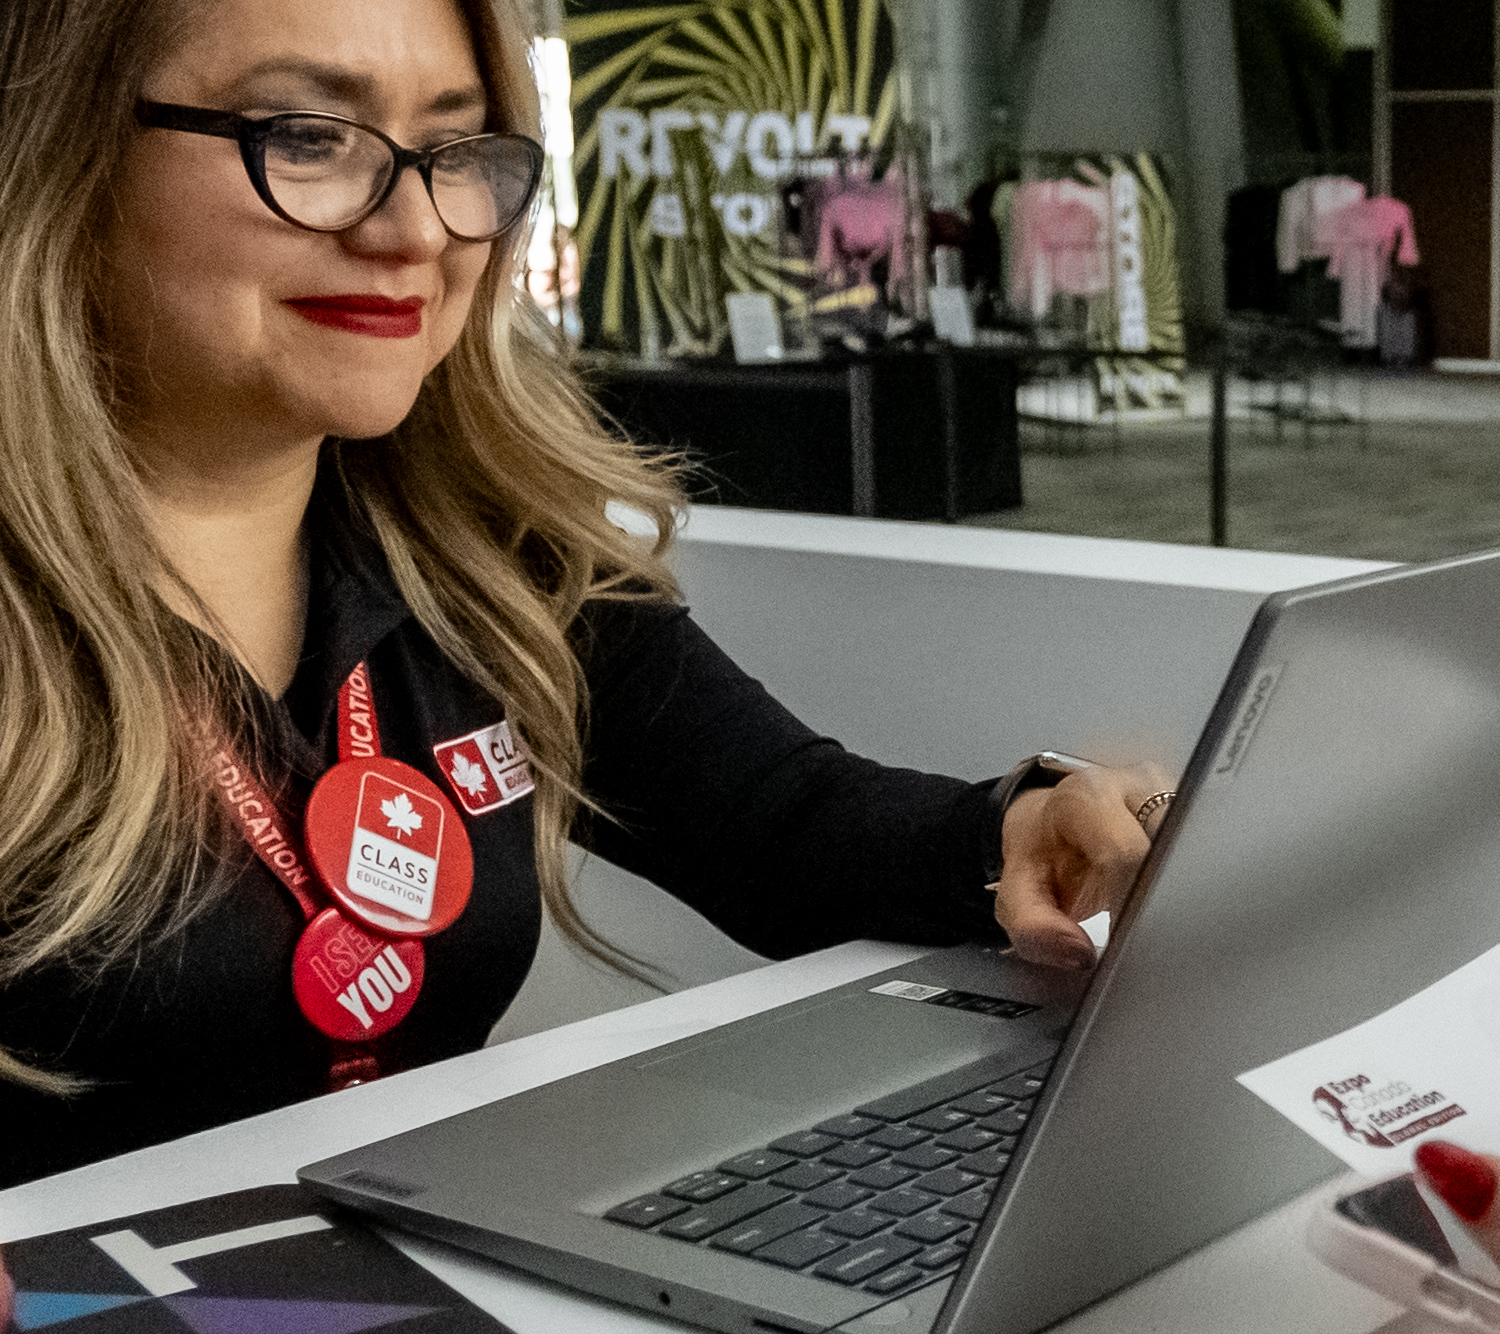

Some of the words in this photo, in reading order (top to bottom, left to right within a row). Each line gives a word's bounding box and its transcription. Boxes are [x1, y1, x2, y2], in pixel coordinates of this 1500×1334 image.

[361, 844, 429, 884] CLASS
[357, 871, 424, 905] EDUCATION
[324, 924, 384, 978] SE
[309, 955, 340, 994] I
[337, 945, 412, 1030] YOU
[1326, 1074, 1371, 1095] Expo
[1368, 1090, 1447, 1128] Education
